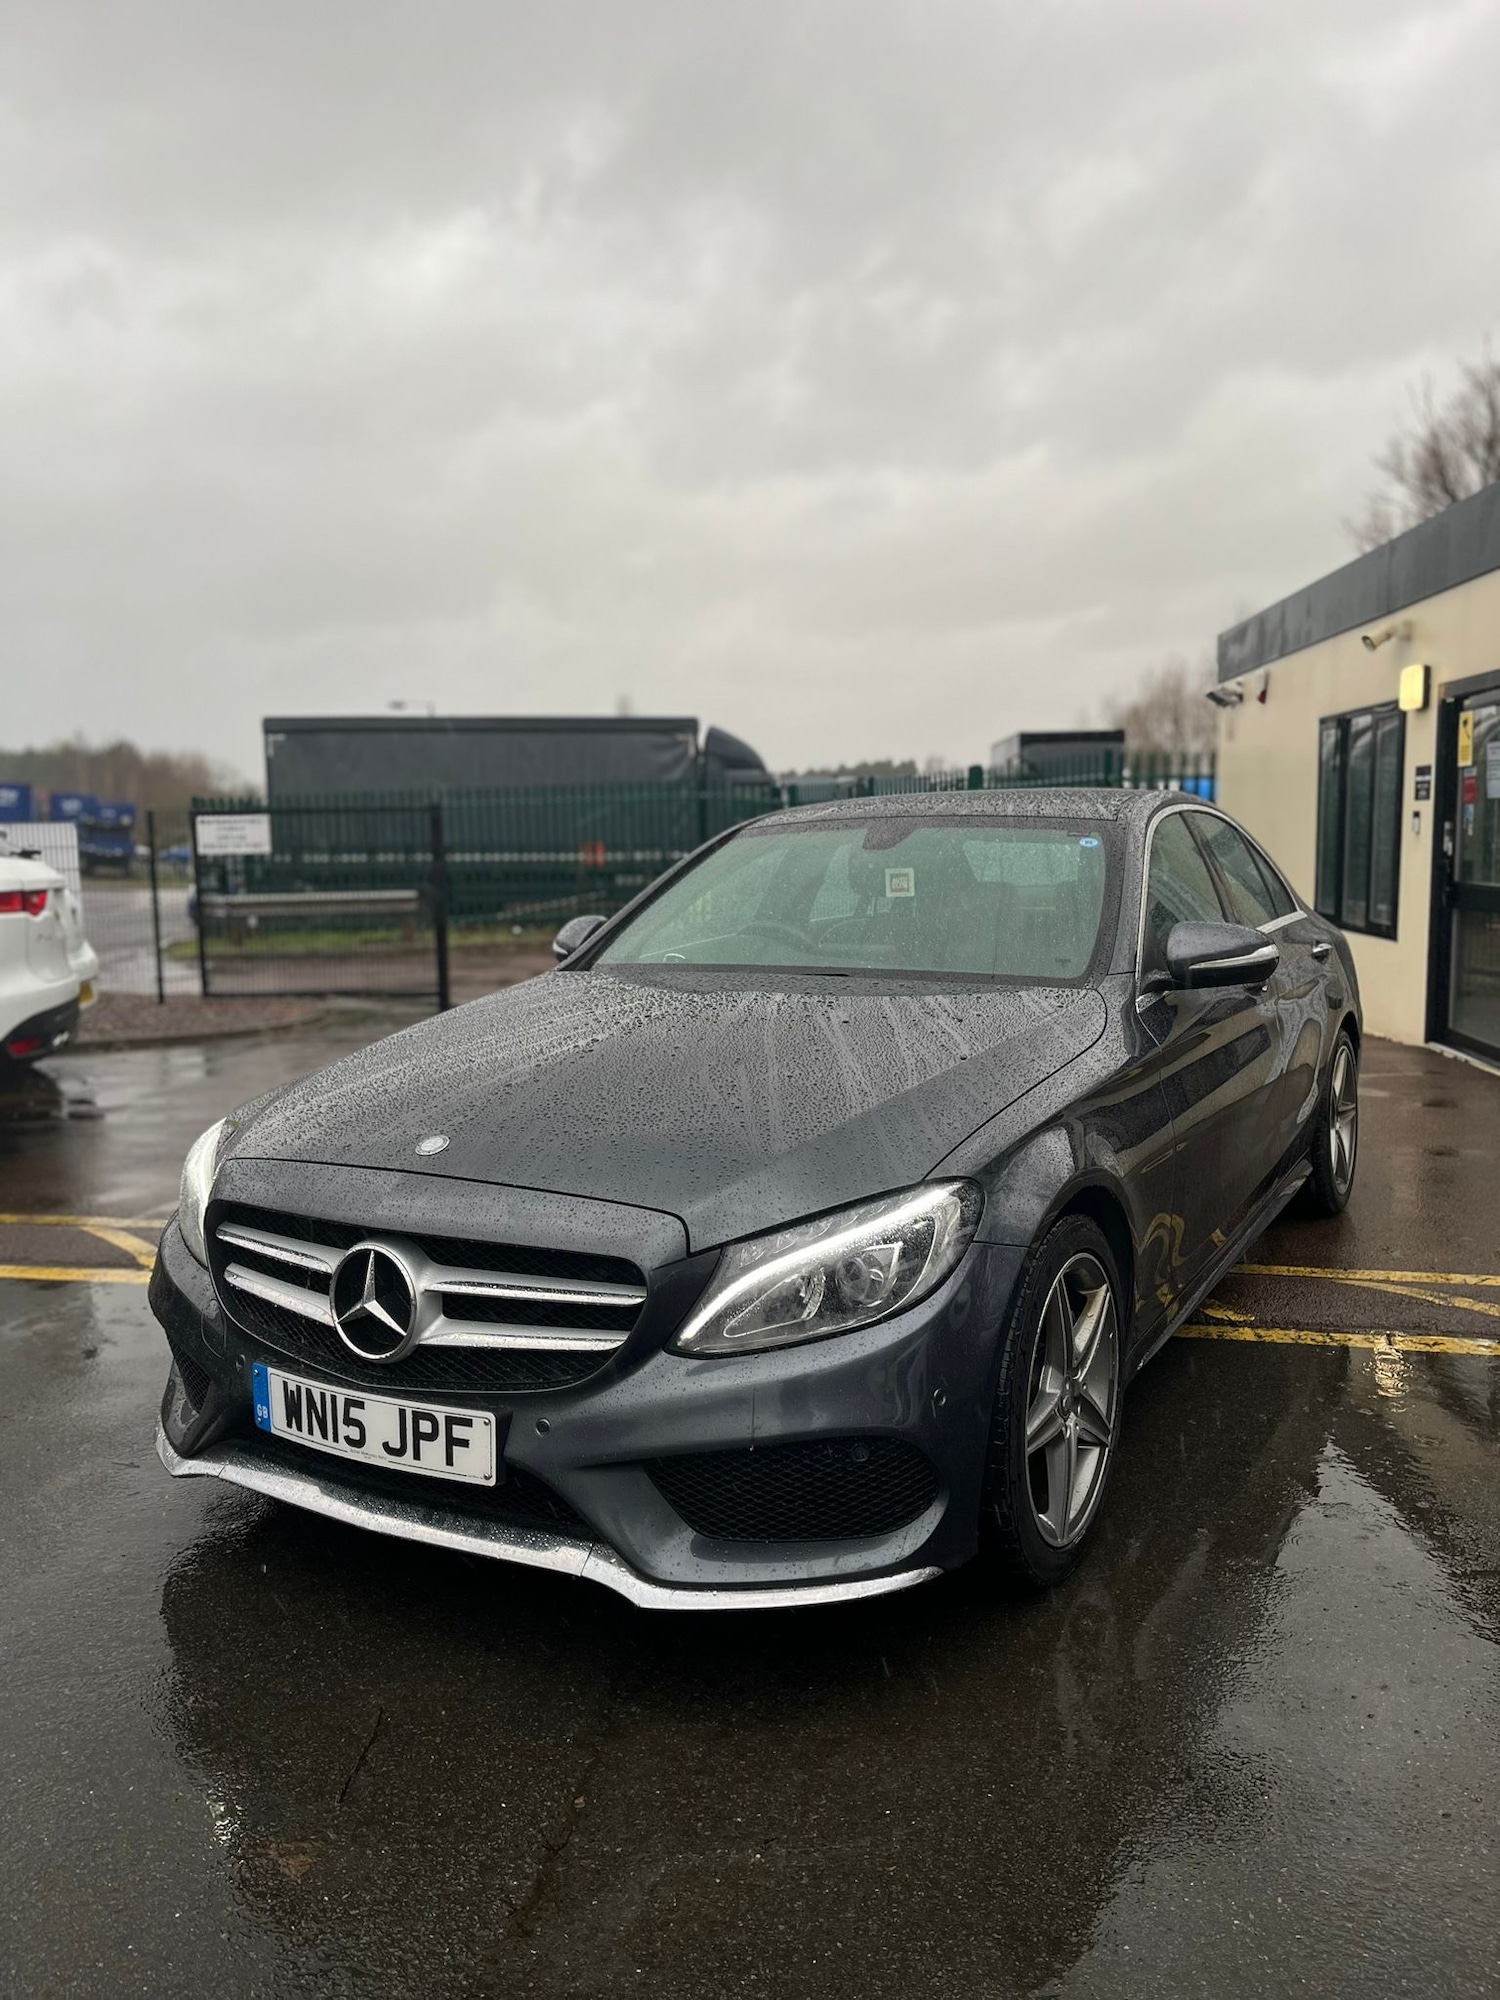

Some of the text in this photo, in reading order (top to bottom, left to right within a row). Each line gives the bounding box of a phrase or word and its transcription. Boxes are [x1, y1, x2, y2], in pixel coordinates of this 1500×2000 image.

[256, 1403, 269, 1419] GB
[282, 1380, 473, 1467] WN15 JPF
